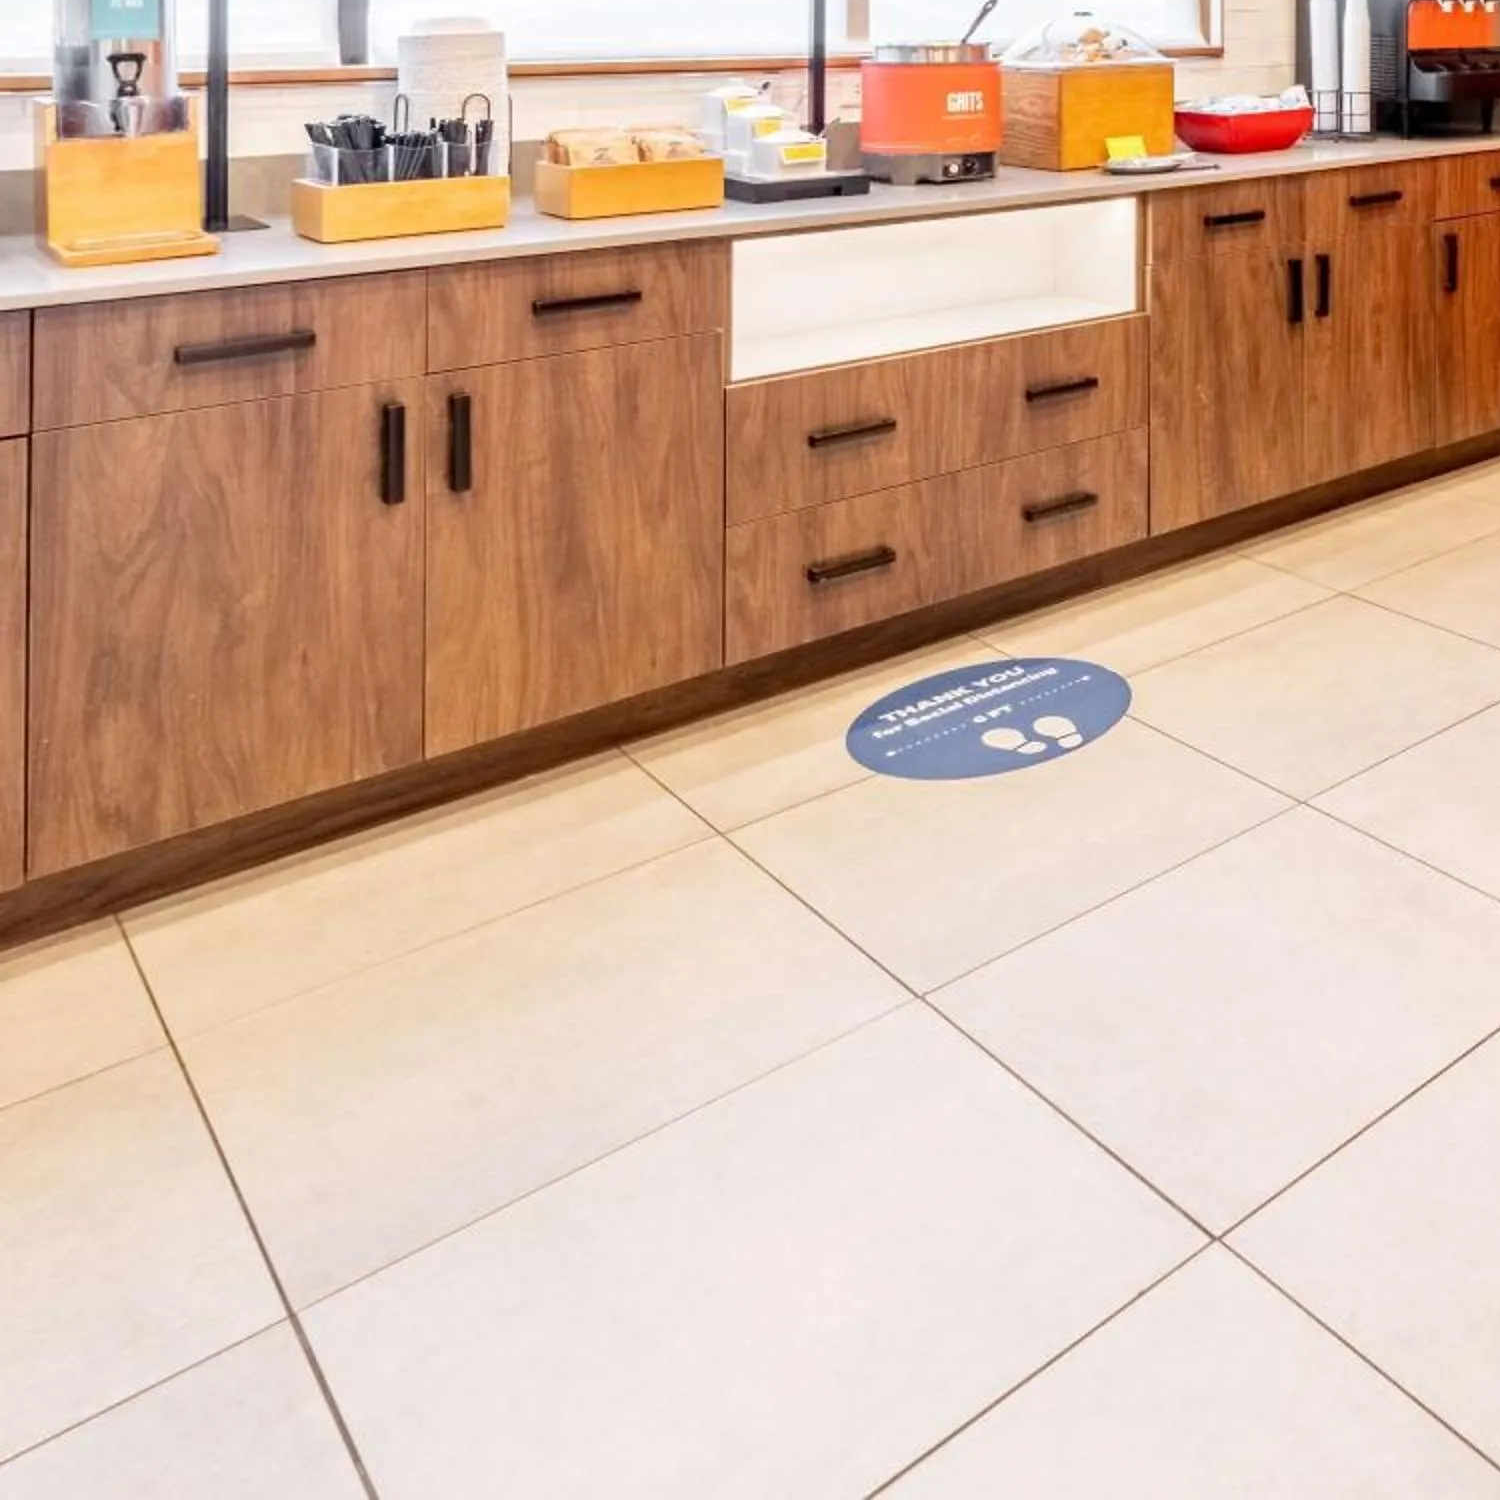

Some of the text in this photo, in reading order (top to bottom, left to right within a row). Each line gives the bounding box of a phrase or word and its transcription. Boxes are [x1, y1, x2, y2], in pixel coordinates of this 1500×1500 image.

[946, 90, 984, 113] GRITS
[877, 665, 1025, 723] THANK YOU
